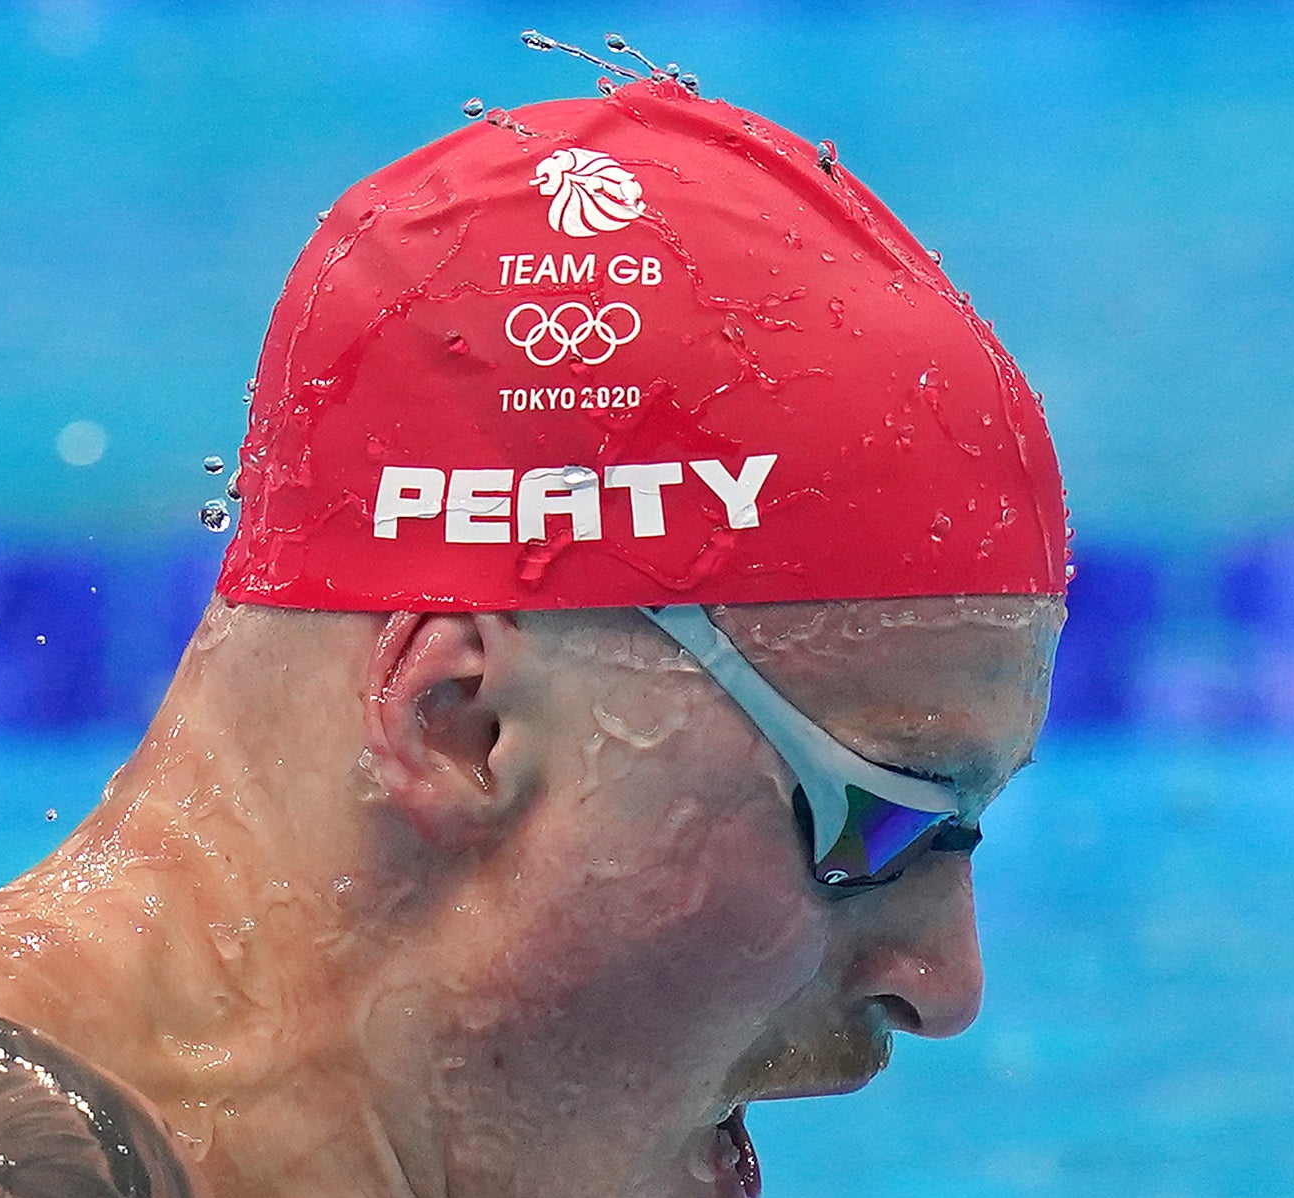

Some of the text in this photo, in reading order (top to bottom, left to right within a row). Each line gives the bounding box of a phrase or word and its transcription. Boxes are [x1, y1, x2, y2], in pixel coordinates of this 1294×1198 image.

[499, 254, 662, 286] TEAM GB
[499, 386, 641, 412] TOKYO 2020
[374, 454, 778, 544] PEATY
